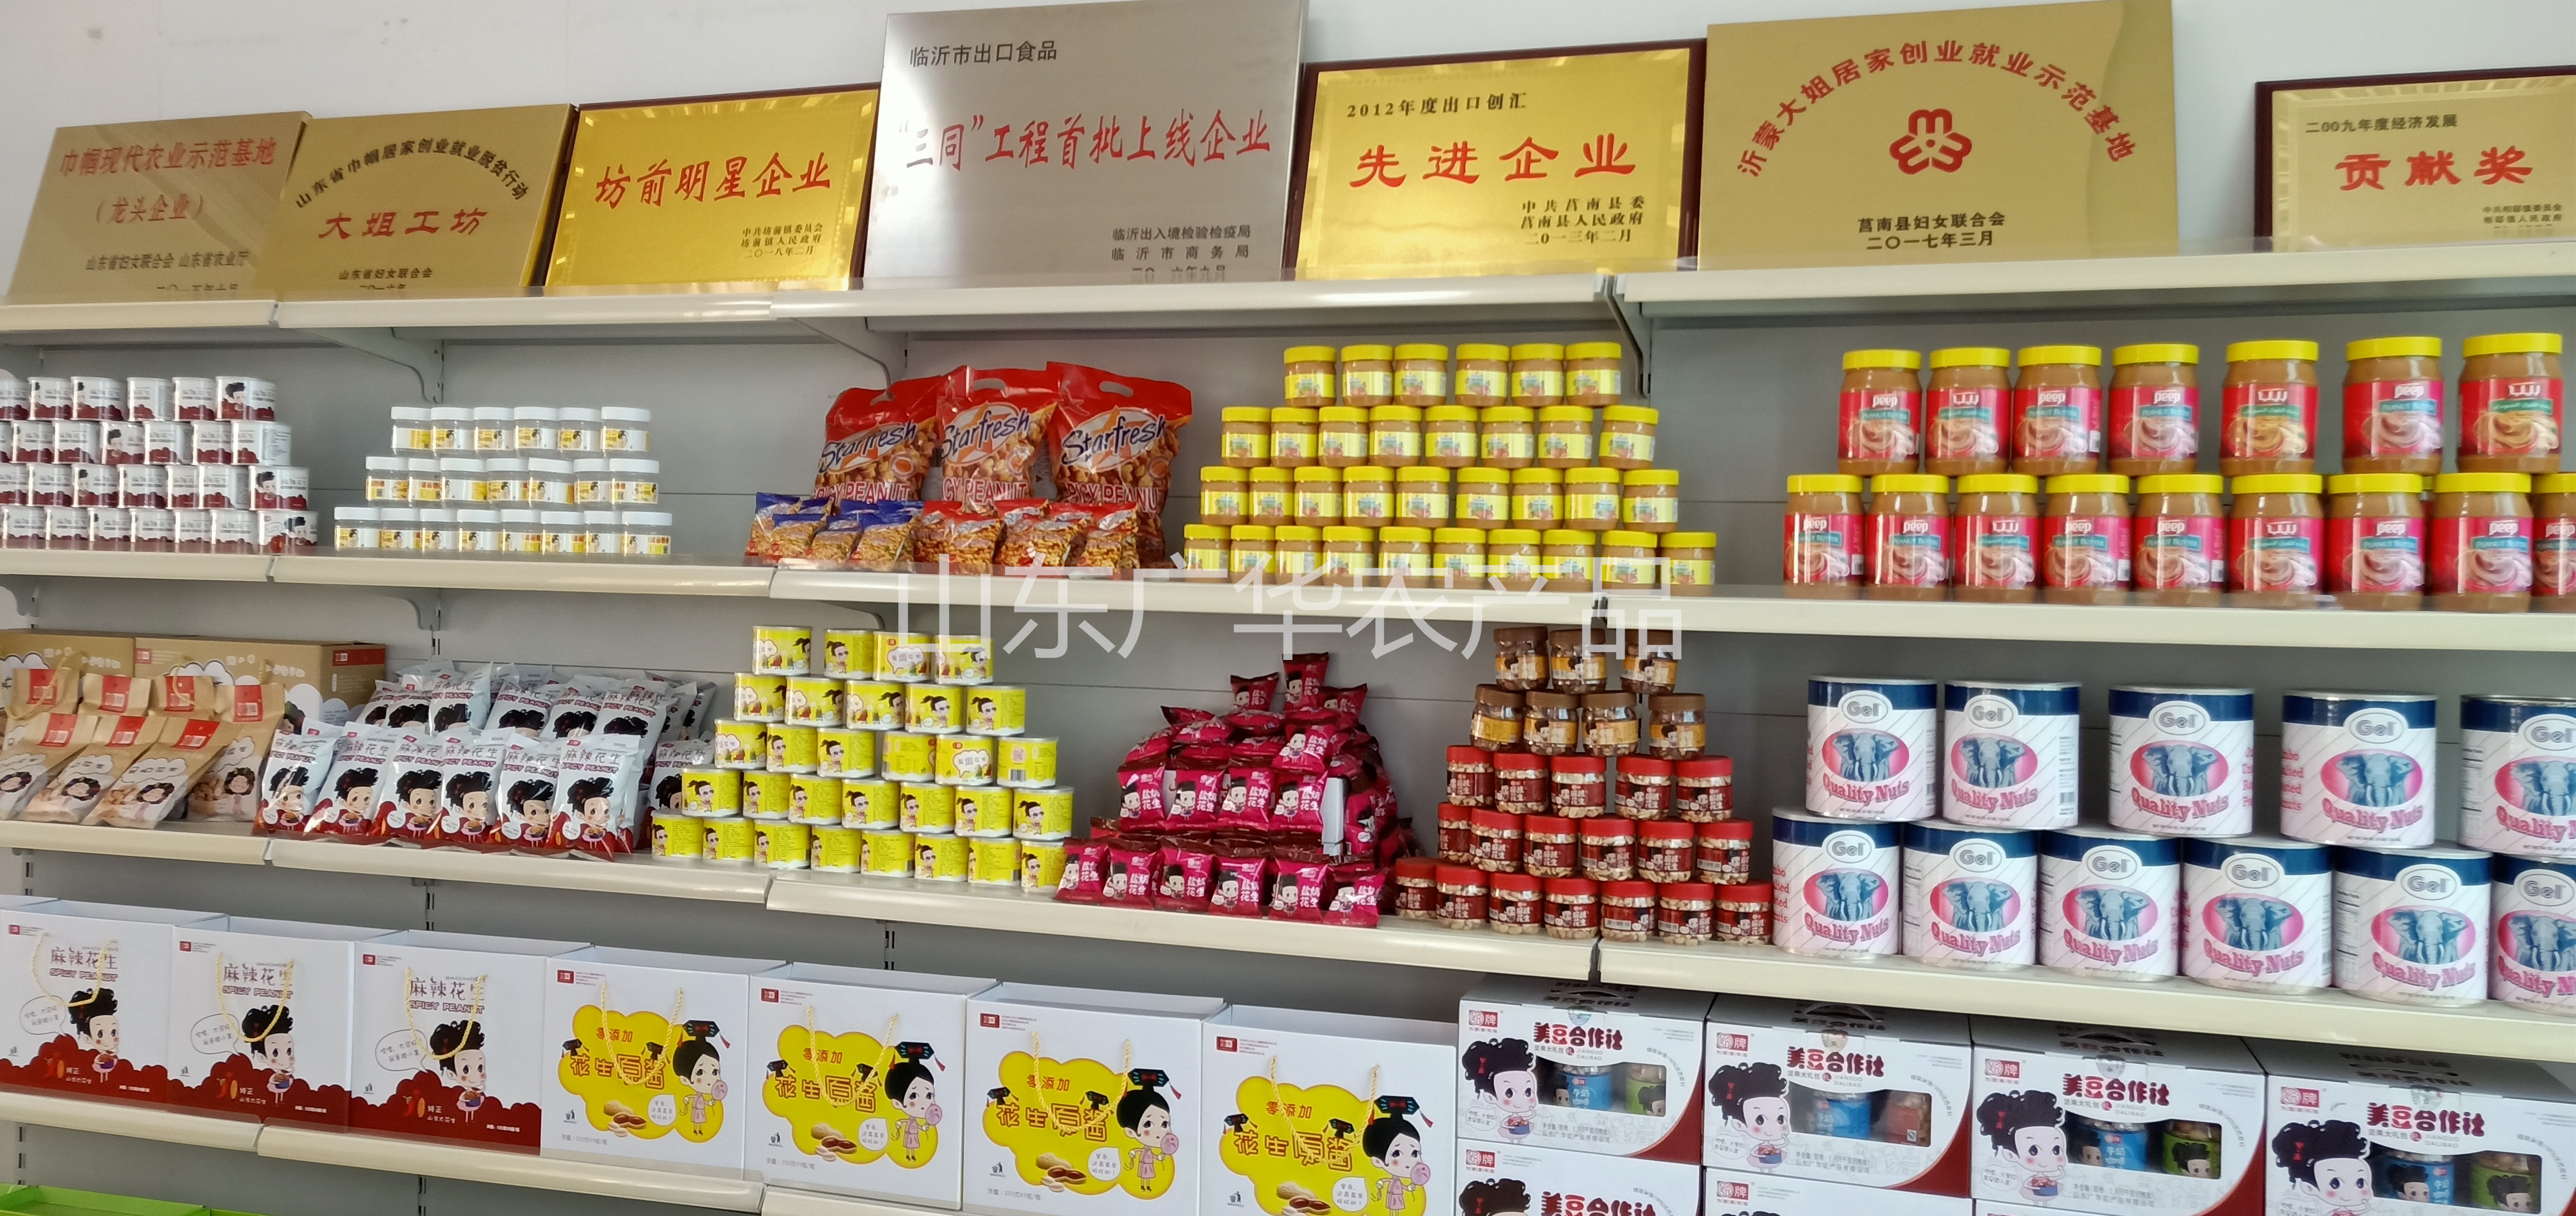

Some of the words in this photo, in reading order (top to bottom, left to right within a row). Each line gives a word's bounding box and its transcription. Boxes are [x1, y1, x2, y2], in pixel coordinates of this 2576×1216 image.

[909, 40, 1058, 67] 临沂市出口食品
[1347, 92, 1527, 118] 2012年度出口创汇
[1737, 40, 2136, 178] 沂蒙大姐居家创业就业示范基地
[60, 136, 277, 177] 巾帼现代农业示范基地
[1349, 132, 1636, 188] 先进企业
[295, 137, 529, 208] 山东省巾帼居家创业就业脱贫行动
[2334, 145, 2533, 191] 贡献奖
[595, 152, 831, 209] 坊前明星企业
[318, 208, 487, 239] 大姐工坊
[742, 222, 823, 238] 中共坊前镇委员会
[1521, 212, 1644, 229] 莒南县人民政府
[1858, 211, 2006, 234] 莒南县妇女联合会
[741, 234, 822, 248] 坊前镇人民政府
[1112, 224, 1251, 241] 临沂出入境检验检疫局
[86, 253, 174, 270] 山东省妇女联合会
[1112, 244, 1249, 262] 临沂市商务局
[339, 267, 433, 280] 山东省妇女联合会
[941, 410, 1030, 459] Starfresh
[1062, 415, 1166, 465] Starfresh
[818, 421, 916, 473] Starfresh
[845, 481, 911, 503] PEANUT
[1846, 701, 1881, 718] Gel
[1972, 705, 2006, 723] Gel
[2158, 712, 2197, 729] Gel
[2356, 719, 2396, 737] Gel
[399, 743, 440, 758] 麻辣花
[415, 757, 442, 766] PEANU
[1822, 773, 1873, 805] Quality
[1875, 780, 1910, 802] Nuts
[1952, 779, 1999, 813] Quality
[2000, 786, 2038, 810] Nuts
[2131, 789, 2191, 822] Quality
[2192, 794, 2229, 820] Nuts
[2323, 799, 2389, 833] Quality
[2390, 804, 2424, 830] Nuts
[2496, 806, 2566, 841] Quality
[1831, 841, 1865, 857] Gel
[1959, 849, 1995, 866] Gel
[2092, 856, 2129, 874] Gel
[2231, 864, 2270, 882] Gel
[2407, 875, 2450, 894] Gel
[1804, 912, 1858, 944] Quality
[1860, 917, 1889, 942] Nuts
[1931, 922, 1987, 956] Quality
[1988, 927, 2021, 952] Nuts
[50, 946, 118, 970] 麻辣花生
[2063, 929, 2122, 965] Quality
[2123, 936, 2158, 962] Nuts
[2204, 938, 2265, 976] Quality
[2266, 949, 2304, 974] Nuts
[49, 968, 77, 978] SPICY
[224, 962, 292, 986] 麻辣花生
[2373, 952, 2440, 989] Quality
[2441, 961, 2476, 989] Nuts
[222, 986, 251, 996] SPICY
[410, 976, 484, 1000] 麻辣花生
[409, 1000, 439, 1010] SPICY
[596, 1027, 633, 1043] 零添加
[803, 1048, 842, 1064] 零添加
[1027, 1075, 1069, 1091] 零添加
[1266, 1101, 1312, 1119] 零添加
